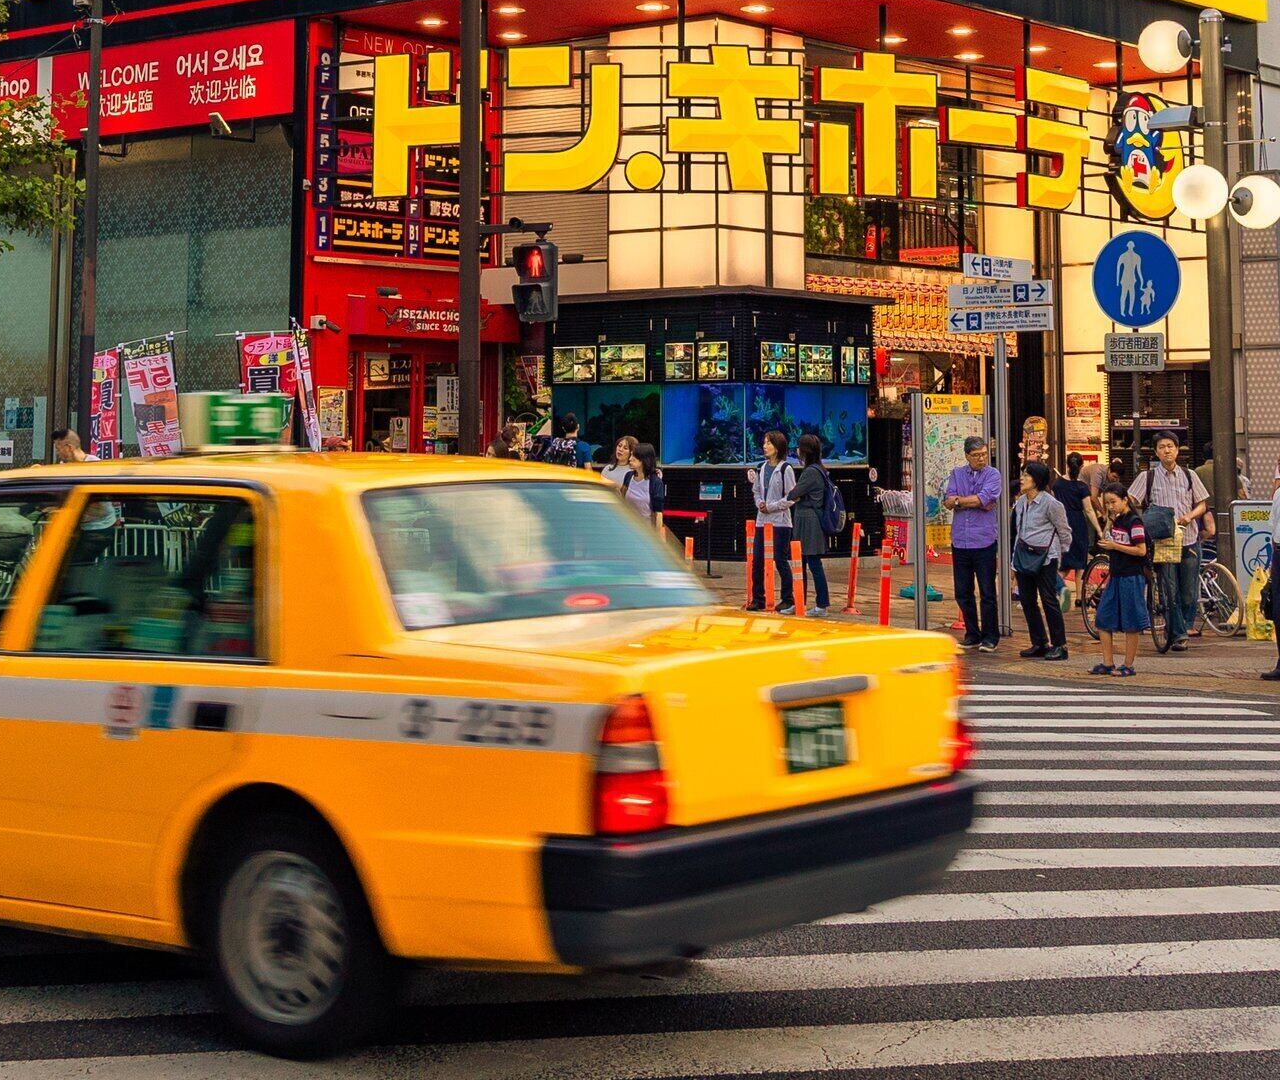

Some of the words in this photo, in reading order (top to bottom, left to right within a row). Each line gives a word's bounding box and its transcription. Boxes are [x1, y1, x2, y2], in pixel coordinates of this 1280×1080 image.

[363, 34, 394, 53] NEW
[176, 53, 209, 78] 어서
[212, 43, 264, 74] 오세요
[78, 61, 160, 90] WELCOME
[189, 75, 256, 105] 欢迎光临
[962, 285, 998, 295] 日ノ出町駅
[416, 322, 440, 331] SINCE
[1110, 336, 1159, 349] 歩行者用道路
[1110, 354, 1159, 366] 特定禁止区間
